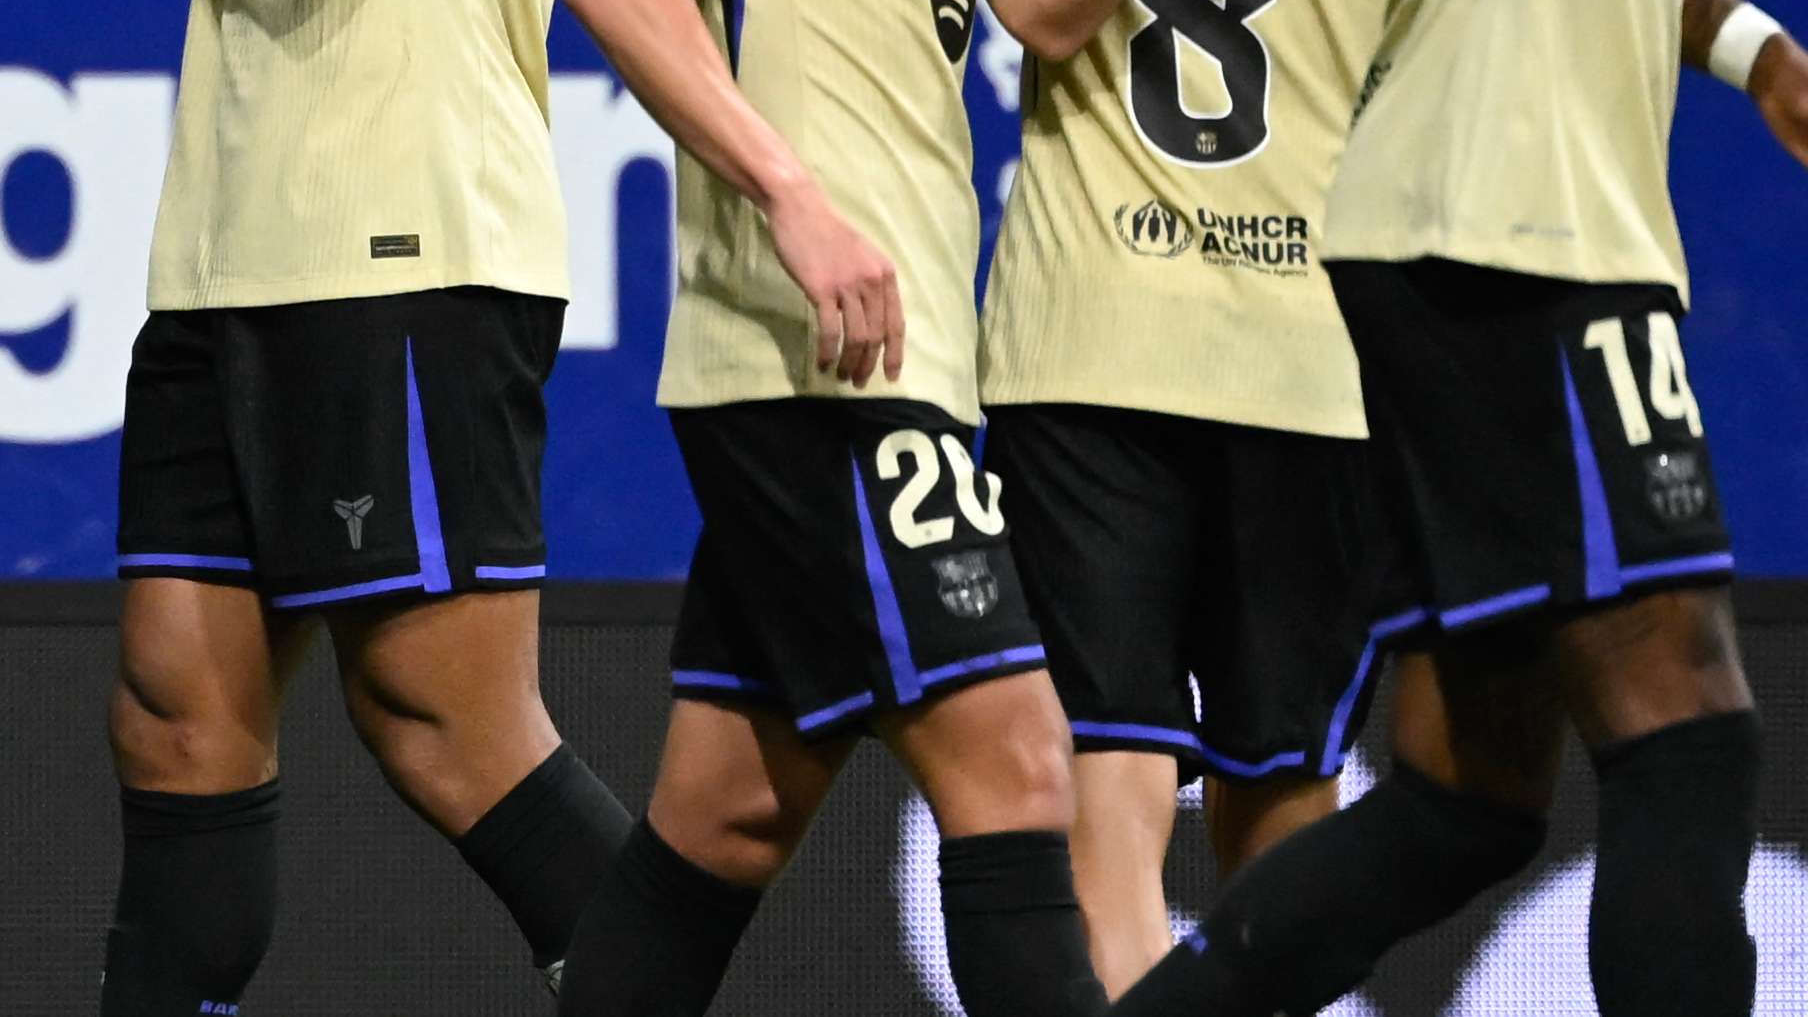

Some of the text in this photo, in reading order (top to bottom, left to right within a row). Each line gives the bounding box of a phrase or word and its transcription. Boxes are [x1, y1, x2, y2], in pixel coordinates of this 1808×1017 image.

[1197, 208, 1308, 240] UNHCR
[1200, 232, 1308, 266] ACNUR
[1583, 312, 1704, 446] 14
[876, 429, 1005, 549] 20
